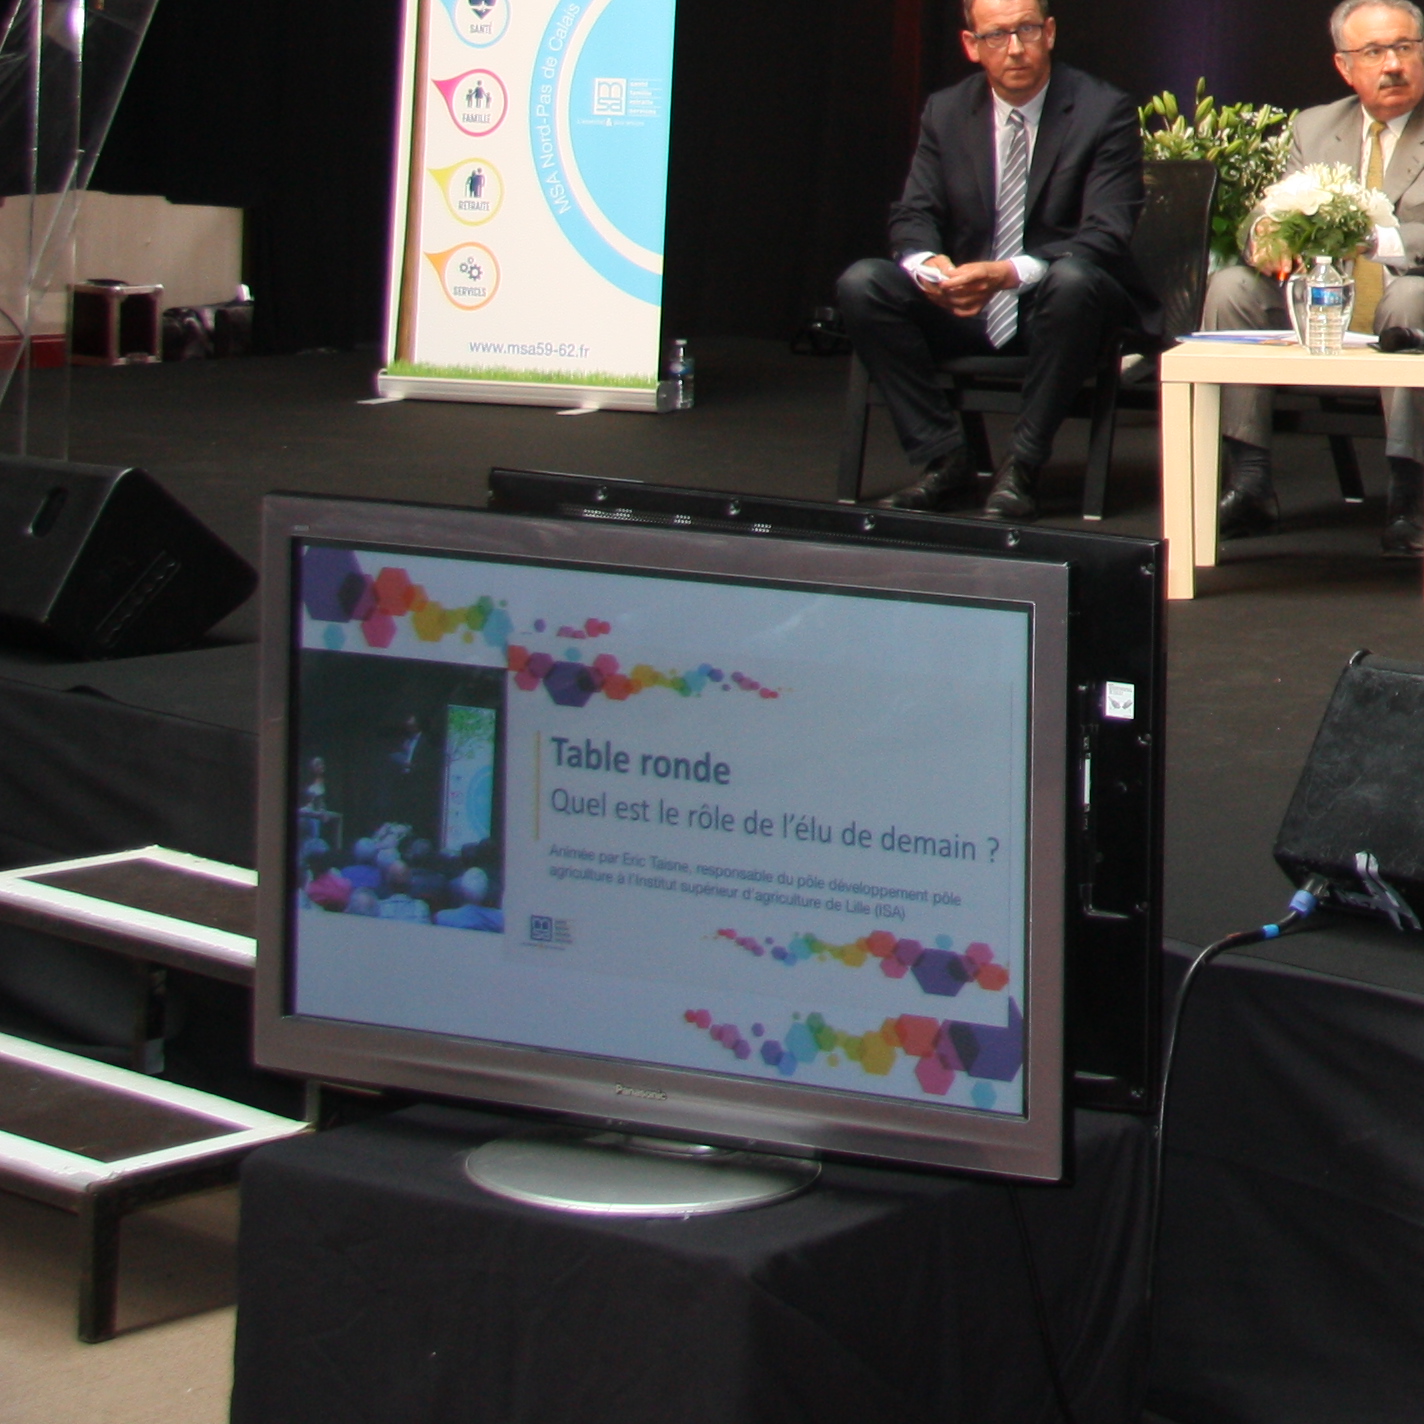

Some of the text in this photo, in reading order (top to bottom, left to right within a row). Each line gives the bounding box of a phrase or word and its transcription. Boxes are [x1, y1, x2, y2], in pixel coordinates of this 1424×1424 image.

[469, 21, 492, 35] SANTÉ
[535, 3, 580, 214] MSA Nord-Pas de Calais
[462, 113, 491, 124] FAMILLE
[458, 200, 490, 211] RETRAITE
[453, 286, 486, 297] SERVICES
[469, 341, 591, 359] www.msa59-62.fr
[551, 736, 731, 785] Table ronde
[551, 788, 607, 817] Quel
[615, 799, 650, 822] est
[659, 798, 680, 825] le
[688, 802, 735, 833] rôle
[743, 809, 774, 837] de
[841, 821, 872, 848] de
[881, 825, 976, 861] demain
[987, 836, 1000, 863] ?
[550, 844, 596, 861] Animée
[599, 852, 619, 865] par
[696, 864, 774, 883] responsable
[777, 871, 794, 886] du
[797, 873, 825, 890] pôle
[828, 878, 929, 902] développement
[932, 889, 962, 907] pôle
[550, 864, 614, 884] agriculture
[617, 871, 625, 884] à
[680, 882, 738, 898] supérieur
[825, 897, 842, 911] de
[846, 899, 870, 915] Lille
[874, 904, 906, 921] (ISA)
[615, 1083, 667, 1101] Panasonic
